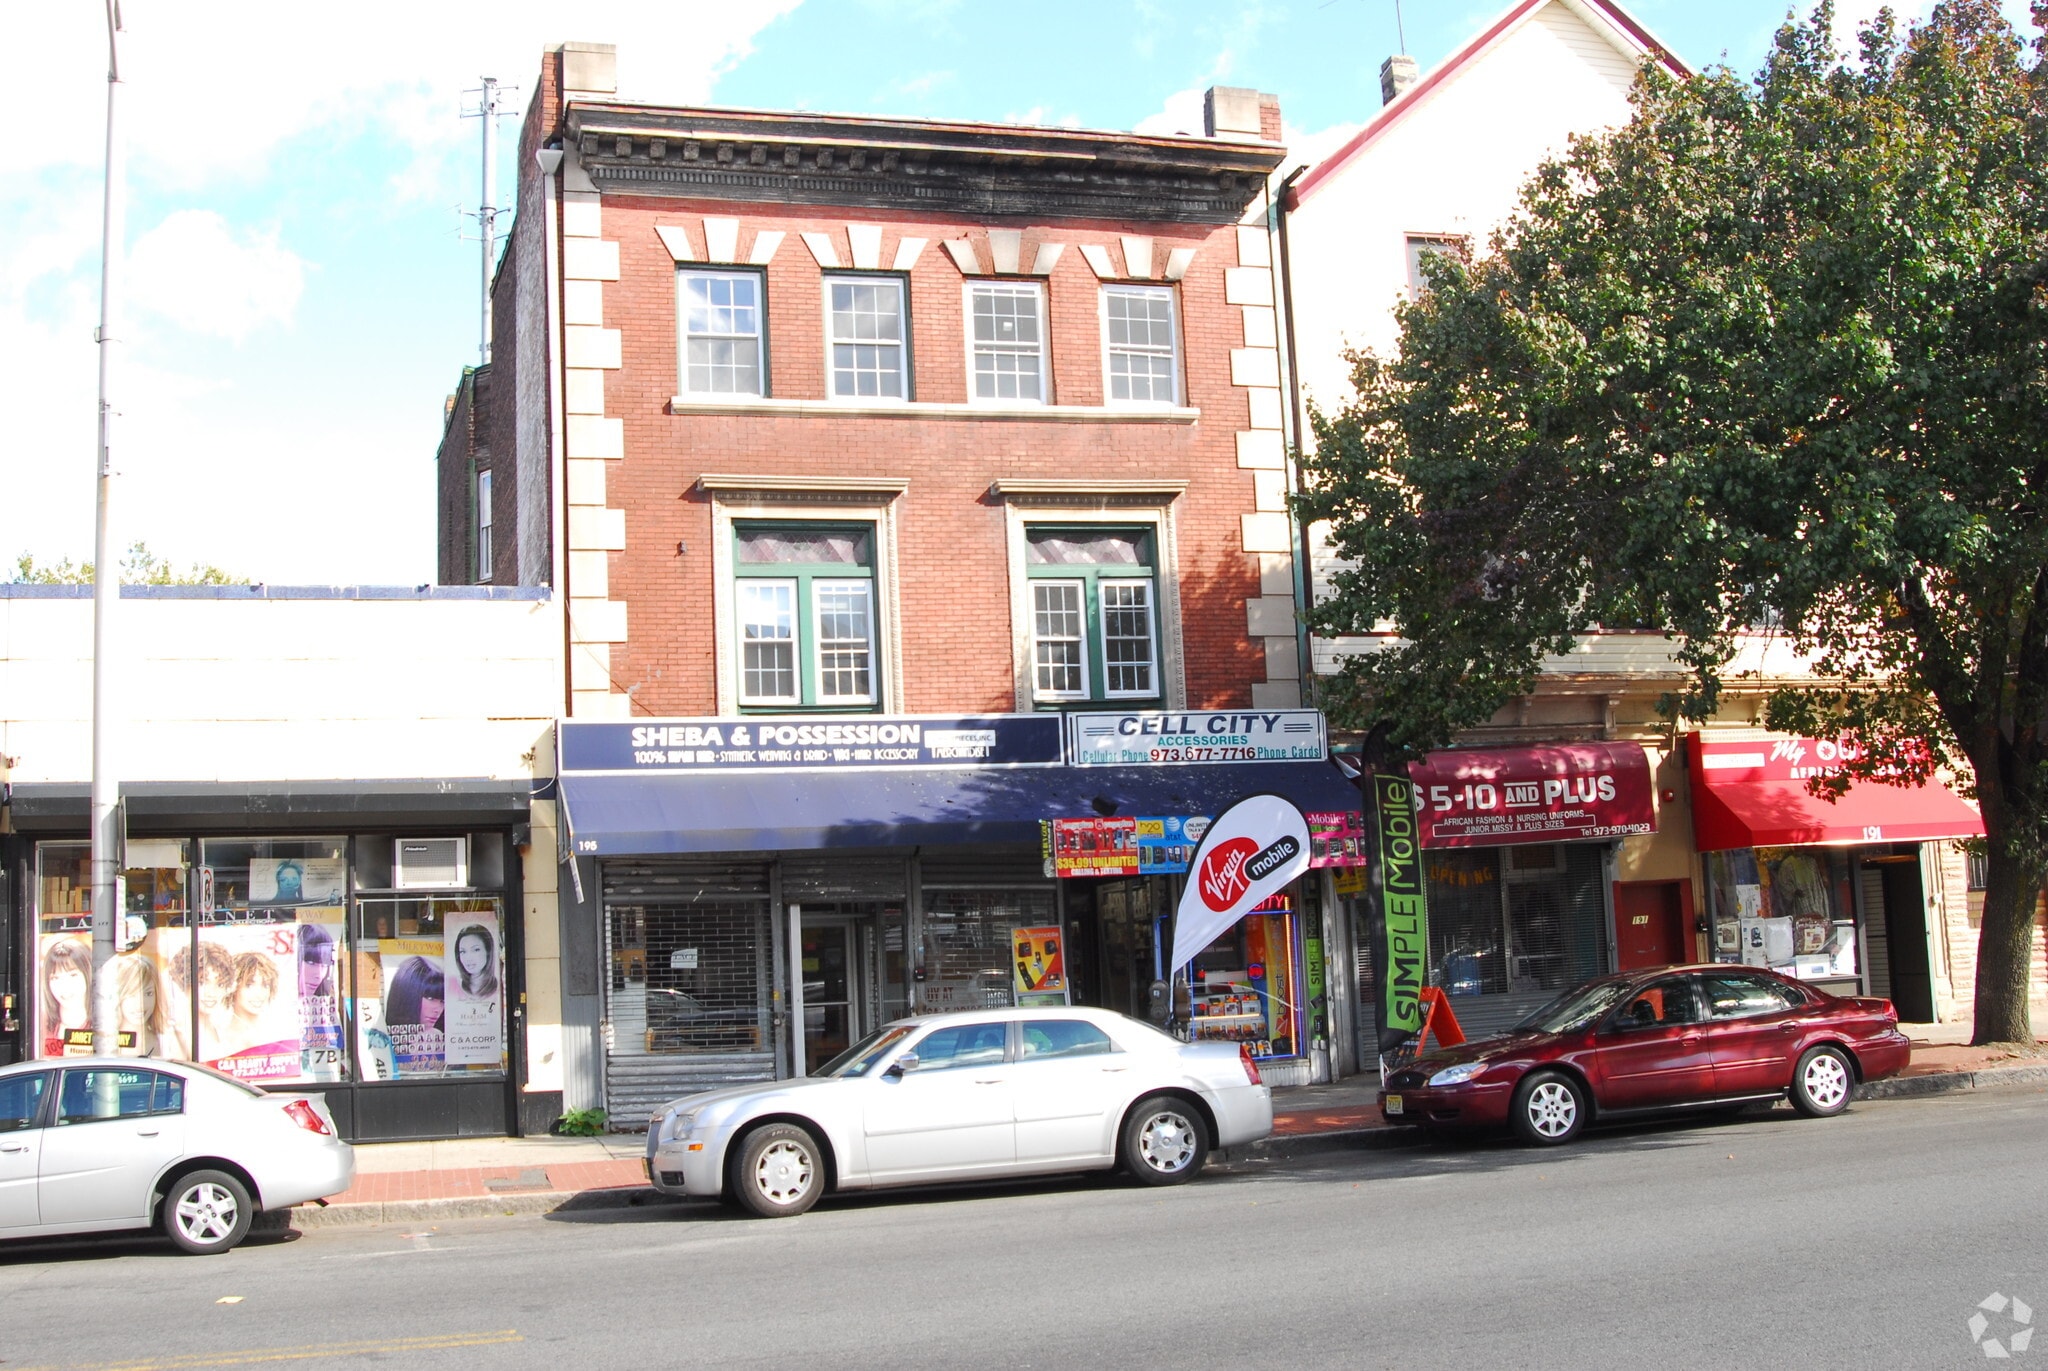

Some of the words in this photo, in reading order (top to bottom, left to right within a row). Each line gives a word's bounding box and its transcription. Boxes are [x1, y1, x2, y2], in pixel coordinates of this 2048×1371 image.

[1118, 715, 1196, 735] CELL
[1207, 714, 1281, 734] CITY
[632, 726, 724, 747] SHEBA
[730, 726, 751, 746] &
[759, 724, 920, 746] POSSESSION
[1157, 735, 1248, 747] ACCESSORIES
[634, 750, 667, 764] 100%
[874, 748, 919, 760] ACCESSORY
[1082, 750, 1117, 763] Cellular
[1122, 749, 1149, 762] Phone
[1150, 747, 1256, 762] 973.677-7716
[1257, 748, 1287, 760] Phone
[1291, 746, 1320, 759] Cards
[1770, 740, 1807, 766] My
[1505, 785, 1540, 803] AND
[1544, 775, 1617, 806] PLUS
[1311, 813, 1341, 824] Mobile
[1444, 817, 1474, 827] AFRICAN
[1476, 815, 1506, 825] FASHION
[1508, 815, 1513, 824] &
[1516, 813, 1548, 823] NURSING
[1550, 811, 1585, 821] UNIFORMS
[1383, 782, 1414, 889] Mobile
[1464, 825, 1490, 835] JUNIOR
[1492, 823, 1514, 833] MISSY
[1516, 823, 1522, 832] &
[1525, 821, 1543, 831] PLUS
[1545, 820, 1565, 829] SIZES
[1581, 828, 1592, 837] Tel
[1593, 823, 1651, 836] 973-970-4023
[1862, 826, 1882, 840] 191
[1205, 849, 1246, 901] Virgin
[1251, 842, 1294, 876] mobile
[1391, 897, 1421, 1026] SIMPLE
[472, 1036, 498, 1044] CORP.
[238, 1058, 268, 1069] BEAUTY
[270, 1055, 300, 1066] SUPPLY
[315, 1050, 337, 1064] 7B
